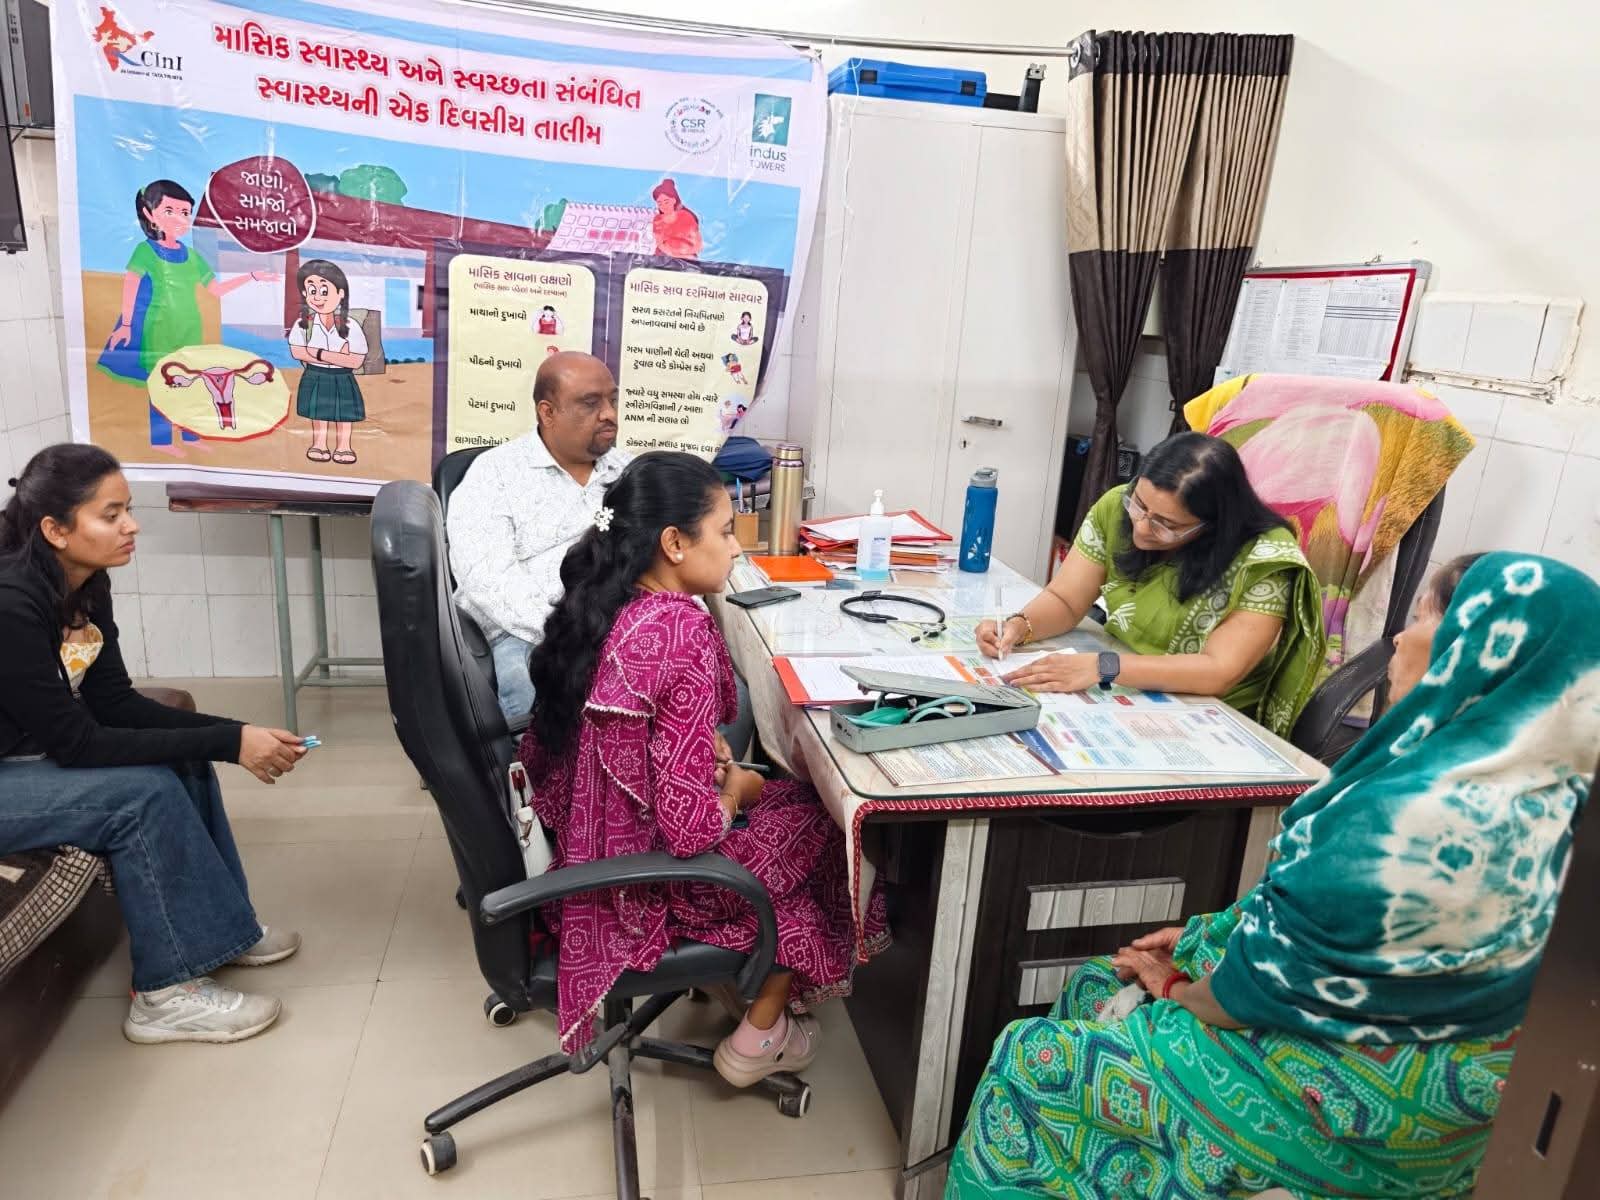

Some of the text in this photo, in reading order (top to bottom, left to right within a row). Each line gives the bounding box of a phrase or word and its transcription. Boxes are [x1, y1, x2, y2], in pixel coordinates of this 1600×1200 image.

[140, 50, 183, 71] CInI
[214, 21, 290, 59] માસિક
[299, 40, 388, 76] સ્વાસ્થ્ય
[398, 57, 444, 86] અને
[453, 70, 546, 99] સ્વચ્છતા
[556, 77, 641, 109] સંબંધિત
[258, 76, 601, 144] સ્વાસ્થ્યની એક દિવસીય તાલીમ
[680, 118, 706, 128] CSR
[750, 145, 787, 161] indus
[751, 159, 786, 172] TOWERS
[241, 170, 289, 192] જાણો,
[240, 193, 290, 215] સમજો,
[235, 215, 297, 236] સમજાવો
[468, 265, 499, 279] માસિક
[540, 273, 572, 286] લક્ષણો
[630, 281, 660, 294] માસિક
[686, 286, 726, 300] દરમિયાન
[729, 291, 762, 304] સારવાર
[470, 307, 499, 318] માથાનો
[469, 354, 522, 370] પીઠનો દુખાવો
[490, 401, 516, 413] દુખાવો
[625, 414, 645, 422] ANM
